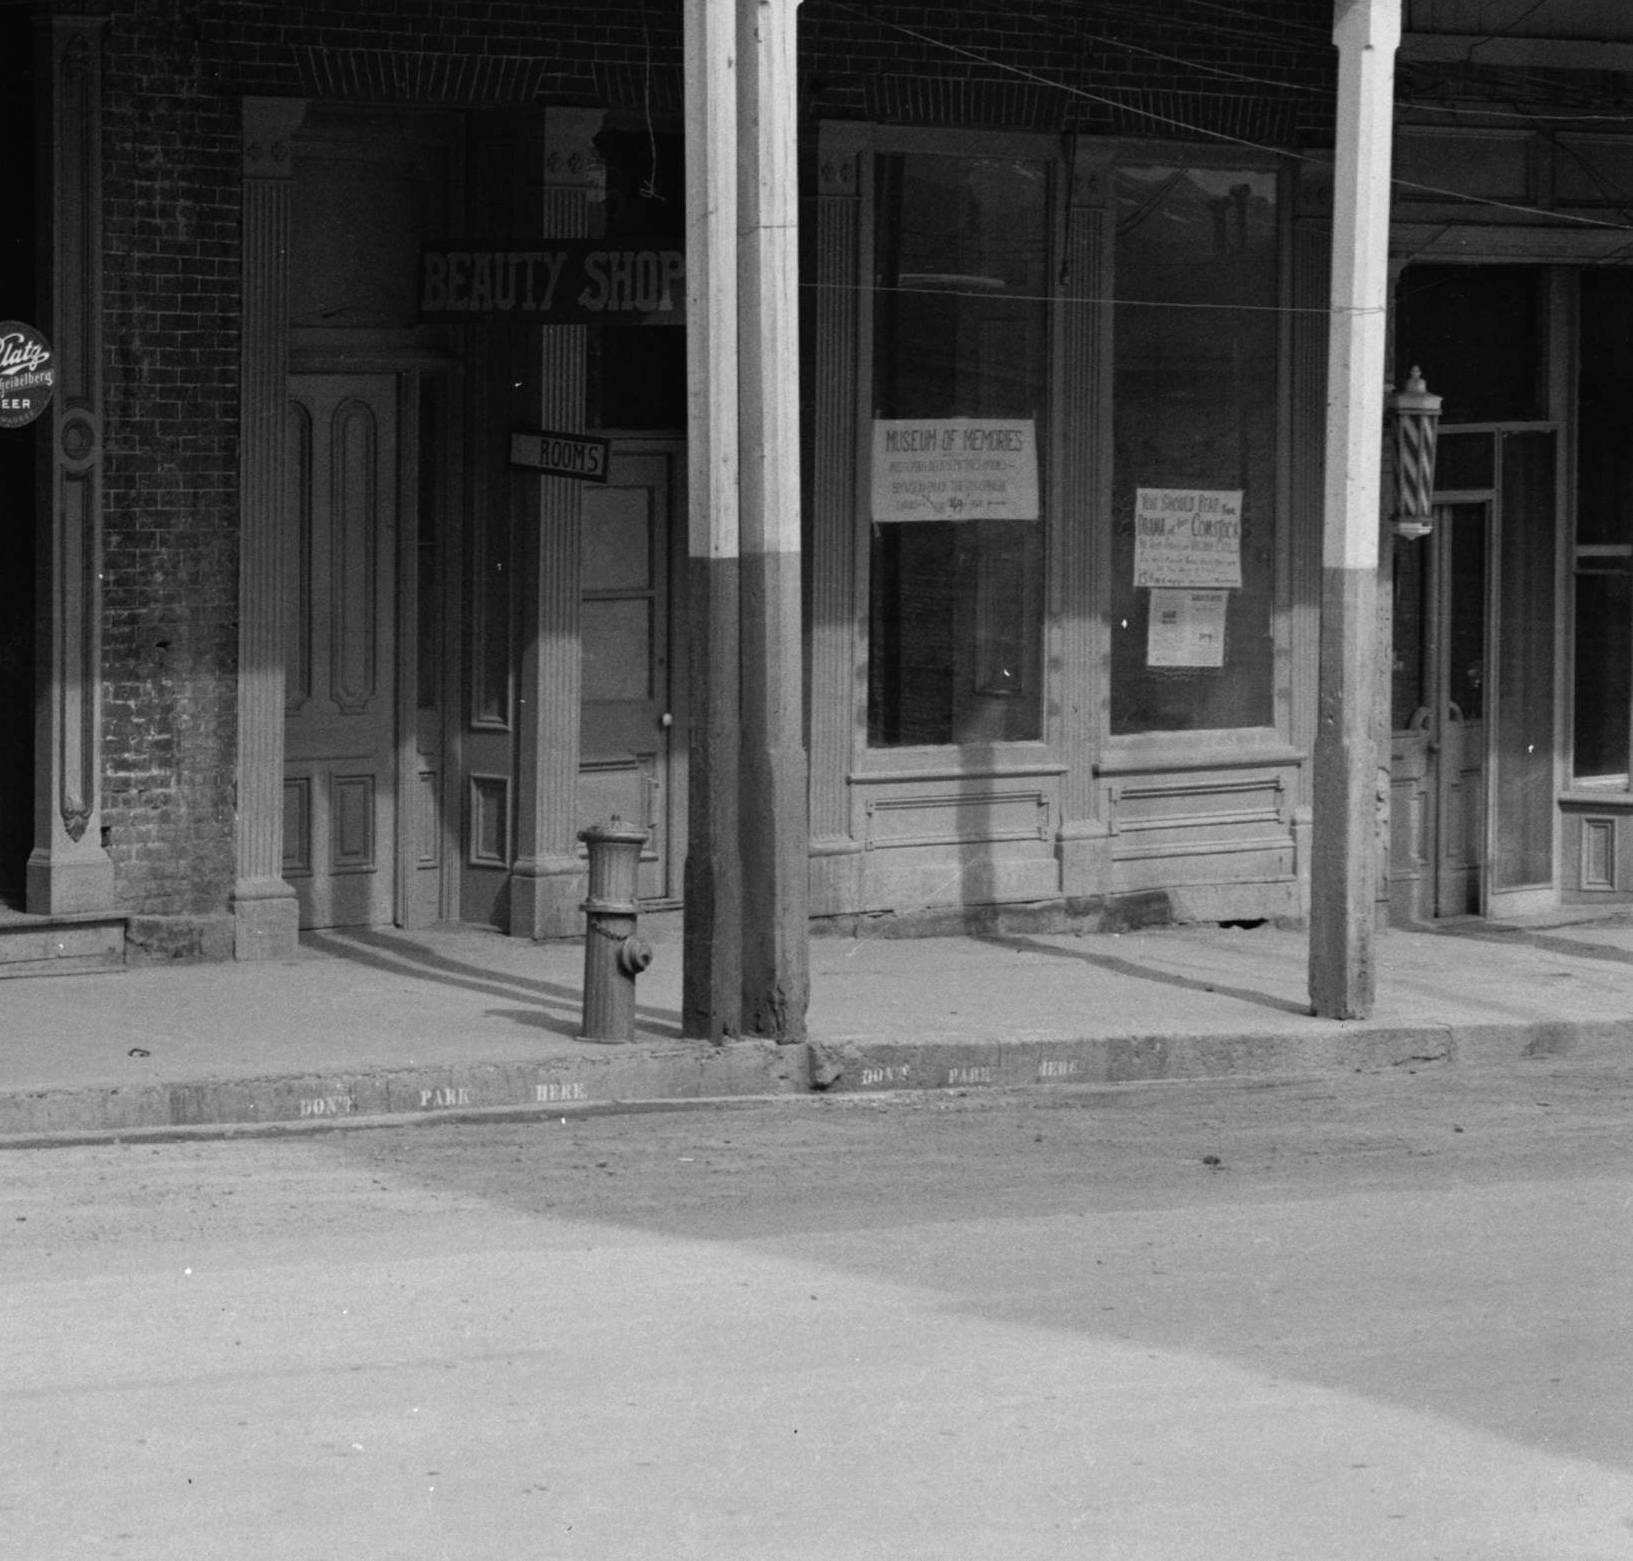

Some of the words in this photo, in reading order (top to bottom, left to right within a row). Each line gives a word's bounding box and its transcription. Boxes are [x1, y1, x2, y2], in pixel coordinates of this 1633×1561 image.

[421, 251, 567, 312] BEAUTY
[577, 250, 686, 312] SHOP
[540, 438, 600, 474] ROOMS
[885, 429, 937, 453] MUSEUM
[942, 429, 958, 452] OF
[964, 429, 1023, 452] MEMORIES
[948, 1065, 992, 1084] PARK
[300, 1094, 358, 1117] DON'T
[420, 1087, 471, 1107] PARK
[535, 1083, 588, 1102] HERE
